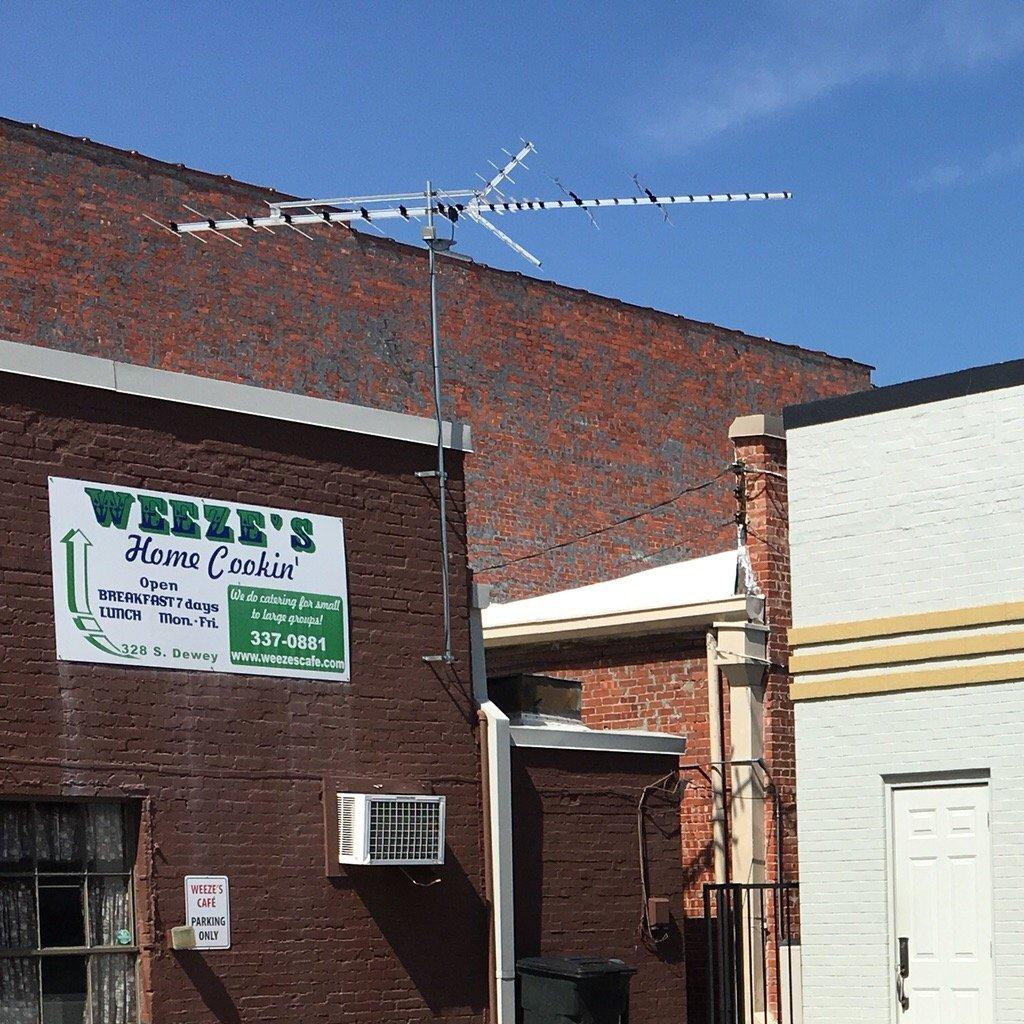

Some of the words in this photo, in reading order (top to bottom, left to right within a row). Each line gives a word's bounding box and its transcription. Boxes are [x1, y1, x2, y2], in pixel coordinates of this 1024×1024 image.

[84, 487, 317, 554] WEEZE'S
[124, 534, 201, 571] Home
[207, 545, 300, 581] Cookin'
[139, 576, 179, 592] Open
[98, 589, 175, 608] BREAKFAST
[176, 597, 183, 609] 7
[184, 598, 220, 615] days
[230, 588, 246, 602] We
[246, 590, 259, 603] do
[259, 593, 298, 610] catering
[299, 595, 314, 611] for
[314, 599, 342, 612] small
[99, 606, 142, 621] LUNCH
[250, 608, 261, 620] to
[261, 608, 288, 625] large
[288, 614, 324, 628] groups!
[250, 630, 327, 652] 337-0881
[120, 643, 149, 656] 328
[152, 646, 168, 658] S.
[171, 648, 219, 664] Dewey
[230, 651, 346, 670] www.weezescafe.com
[191, 885, 223, 894] WEEZE'S
[191, 916, 226, 926] PARKING
[198, 931, 219, 940] ONLY
